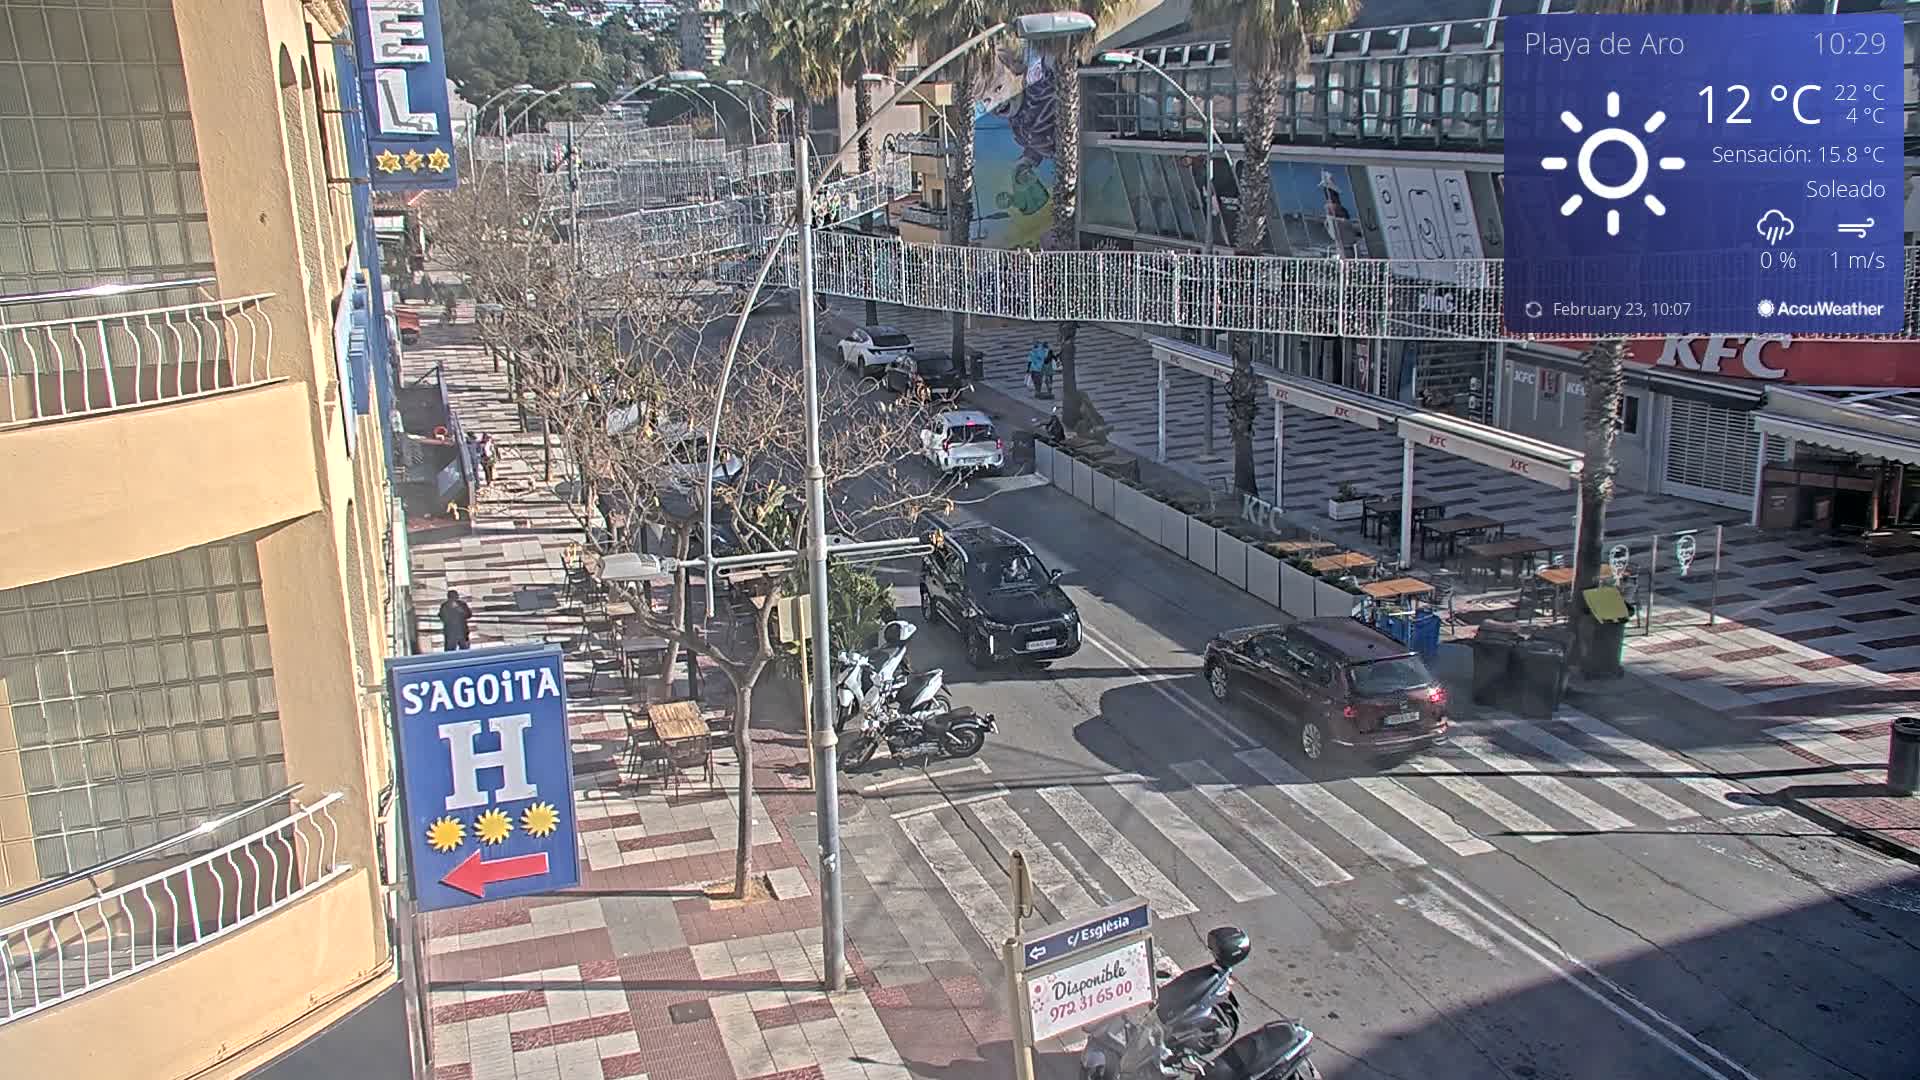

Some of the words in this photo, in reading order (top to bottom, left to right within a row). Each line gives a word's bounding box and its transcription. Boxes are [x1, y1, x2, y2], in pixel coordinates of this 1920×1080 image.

[1656, 331, 1793, 379] KFC
[1513, 369, 1536, 385] KFC
[1429, 434, 1448, 448] KFC
[1510, 458, 1529, 473] KFC
[1241, 493, 1284, 536] KFC
[438, 713, 538, 811] H
[1050, 1001, 1076, 1022] 972
[1080, 994, 1093, 1010] 31
[1096, 986, 1114, 1004] 65
[1116, 980, 1133, 997] 00
[1052, 960, 1127, 1001] Disponible
